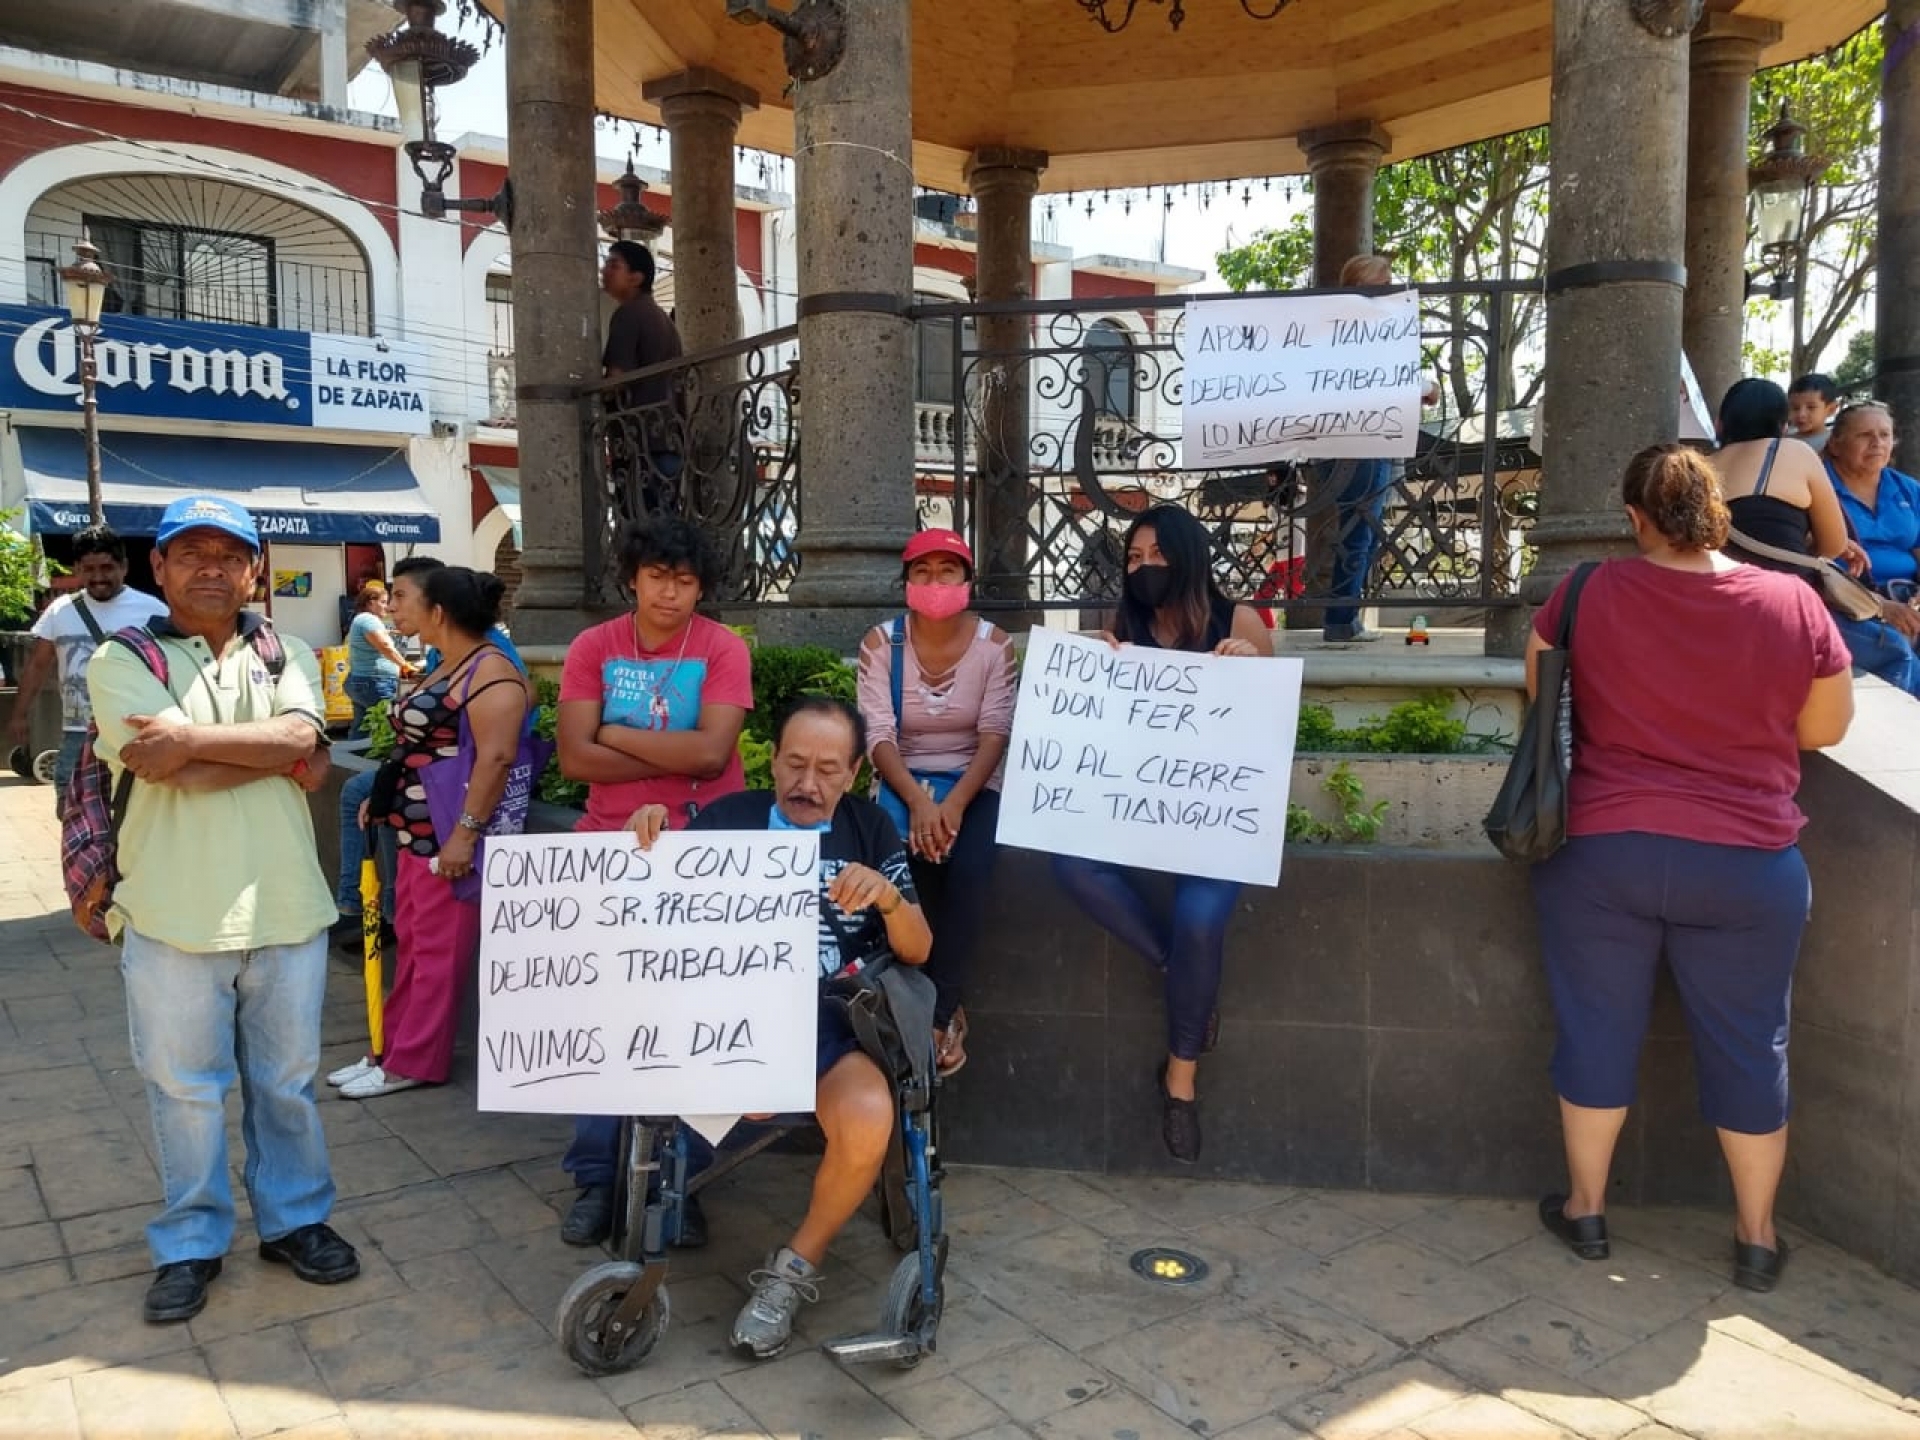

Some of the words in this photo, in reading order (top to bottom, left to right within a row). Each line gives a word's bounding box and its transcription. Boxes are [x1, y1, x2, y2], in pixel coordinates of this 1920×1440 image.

[1198, 324, 1269, 353] APOYO
[1282, 322, 1312, 349] AL
[14, 317, 291, 405] Corona
[326, 357, 350, 377] LA
[357, 360, 406, 383] FLOR
[1190, 371, 1287, 405] DEJENOS
[1305, 361, 1420, 392] TRABAJAR
[319, 385, 345, 406] DE
[350, 387, 424, 412] ZAPATA
[1202, 422, 1229, 448] LO
[1237, 406, 1404, 446] NECESITAMOS
[260, 515, 311, 535] ZAPATA
[374, 521, 421, 537] Corona
[1045, 641, 1203, 694] APOYENOS
[1021, 738, 1062, 771] NO
[1076, 744, 1122, 777] AL
[1136, 755, 1265, 792] CIERRE
[1032, 781, 1086, 814] DEL
[1103, 794, 1260, 834] TIANGUIS
[486, 846, 651, 887] CONTAMOS
[674, 845, 752, 879] CON
[763, 843, 816, 880] SU
[491, 896, 581, 934] APOYO
[655, 889, 819, 926] PRESIDENTE
[490, 952, 599, 995] DEJENOS
[485, 1026, 606, 1073] VIVIMOS
[626, 1025, 668, 1061] AL
[689, 1018, 754, 1057] DIA
